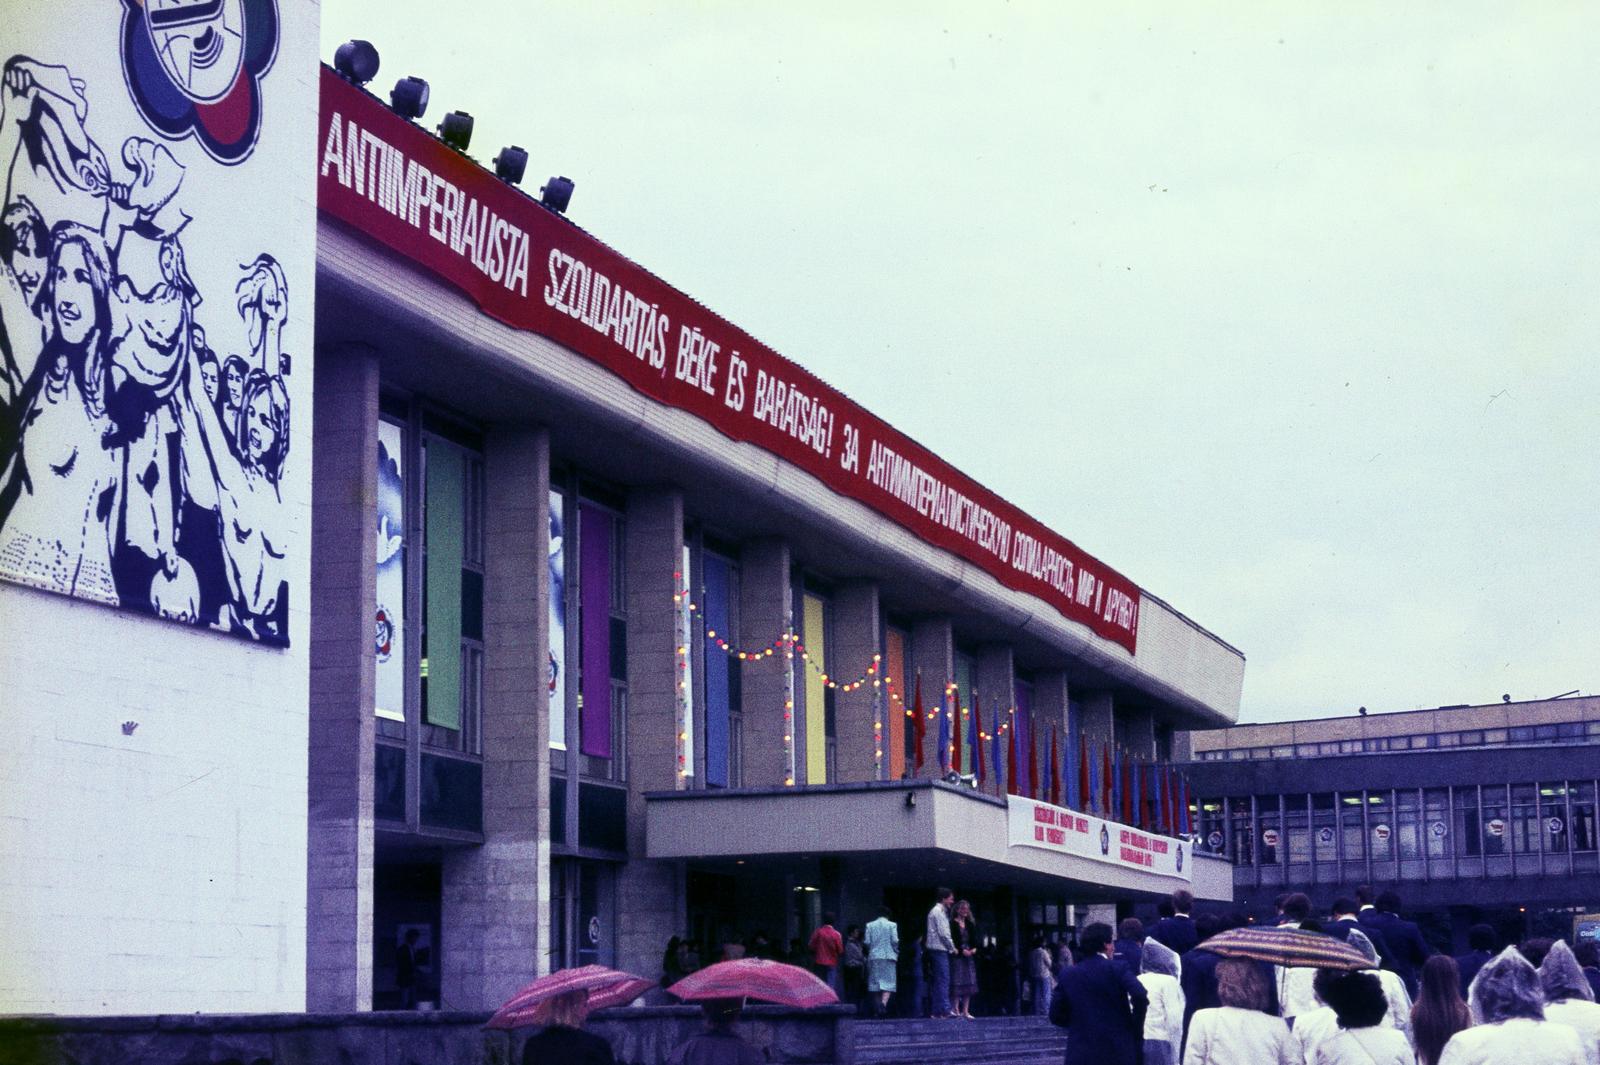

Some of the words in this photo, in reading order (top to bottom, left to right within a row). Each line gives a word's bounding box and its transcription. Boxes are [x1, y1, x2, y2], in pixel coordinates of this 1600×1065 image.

[321, 111, 530, 297] ANTIIMPERIALISTA
[674, 324, 721, 395] BÉKE
[724, 350, 748, 412] ÉS
[753, 368, 834, 458] BARÁTSÁG!
[841, 423, 859, 474] ЗА
[866, 439, 1011, 563] АНТИИМПЕРИАЛИСТИЧЕСКУЮ
[1075, 568, 1095, 608] МИР
[1094, 579, 1103, 615] И
